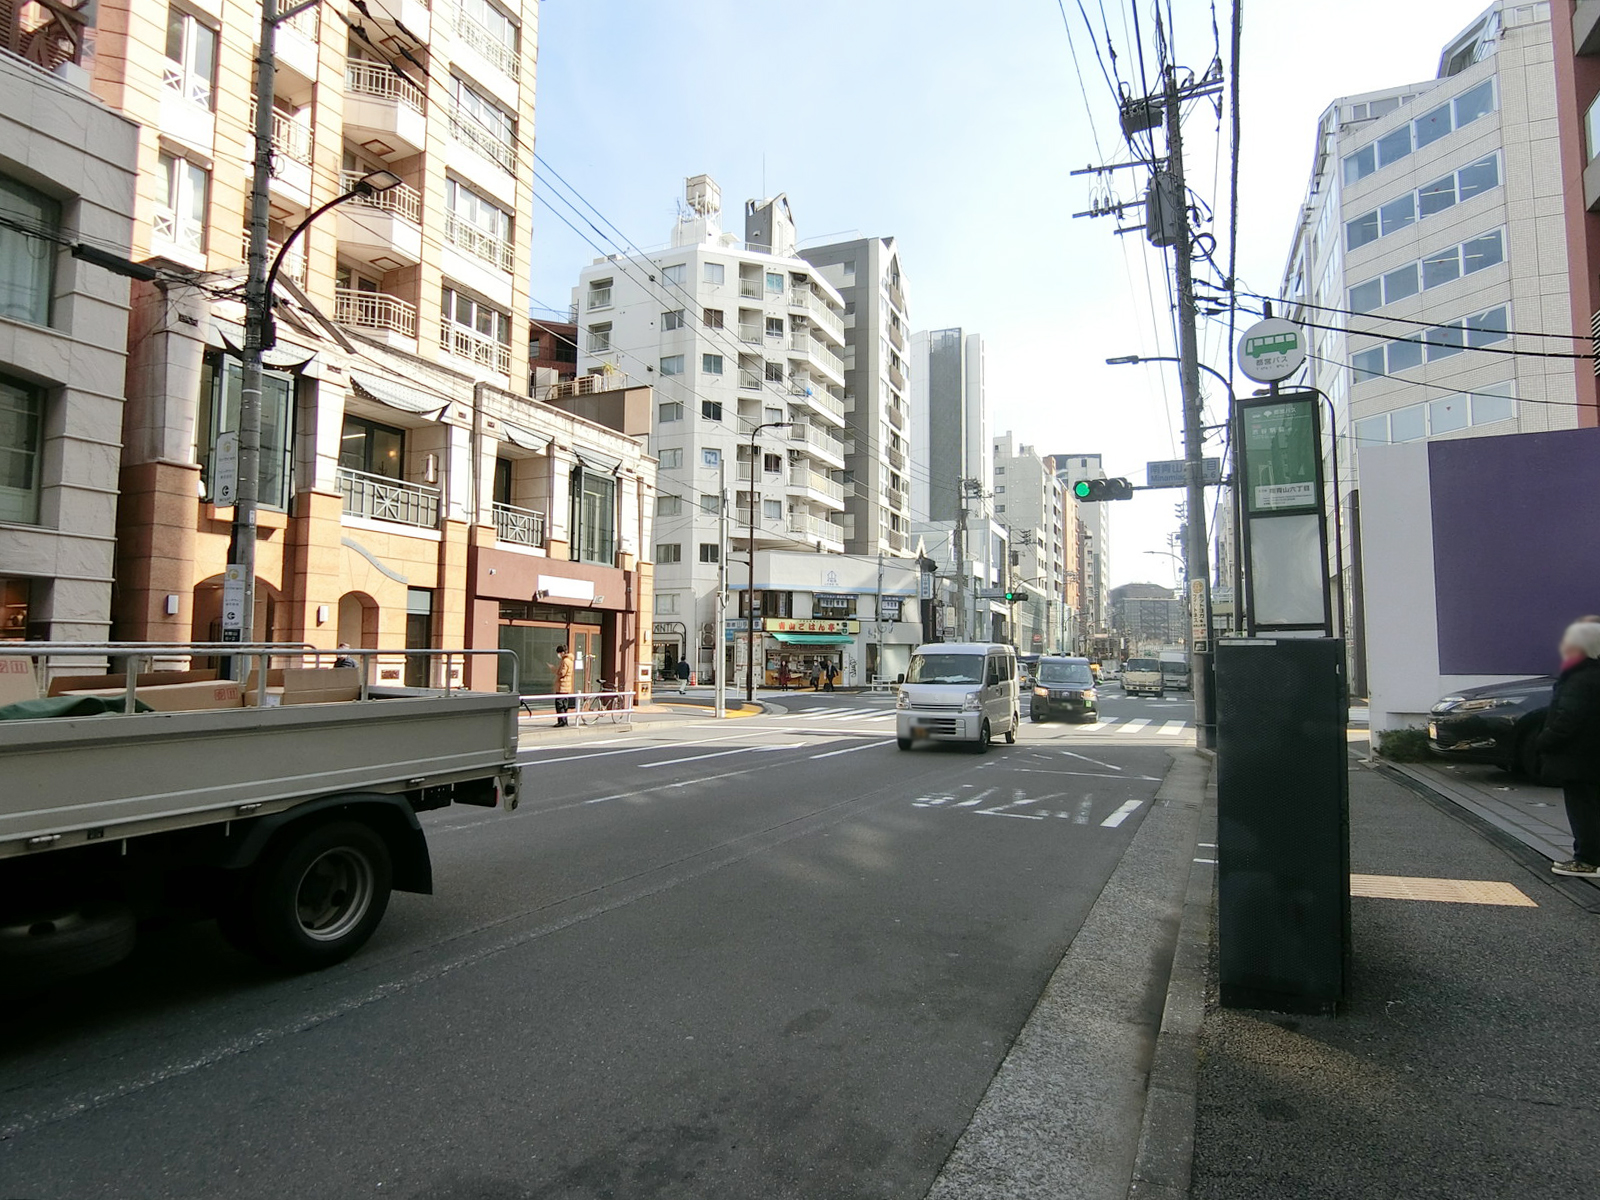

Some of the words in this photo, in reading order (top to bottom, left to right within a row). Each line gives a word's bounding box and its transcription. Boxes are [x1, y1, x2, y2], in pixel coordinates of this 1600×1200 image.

[1256, 356, 1288, 366] 都営バス
[1150, 460, 1217, 474] 南青山目
[779, 622, 836, 632] 青山ごはん亭
